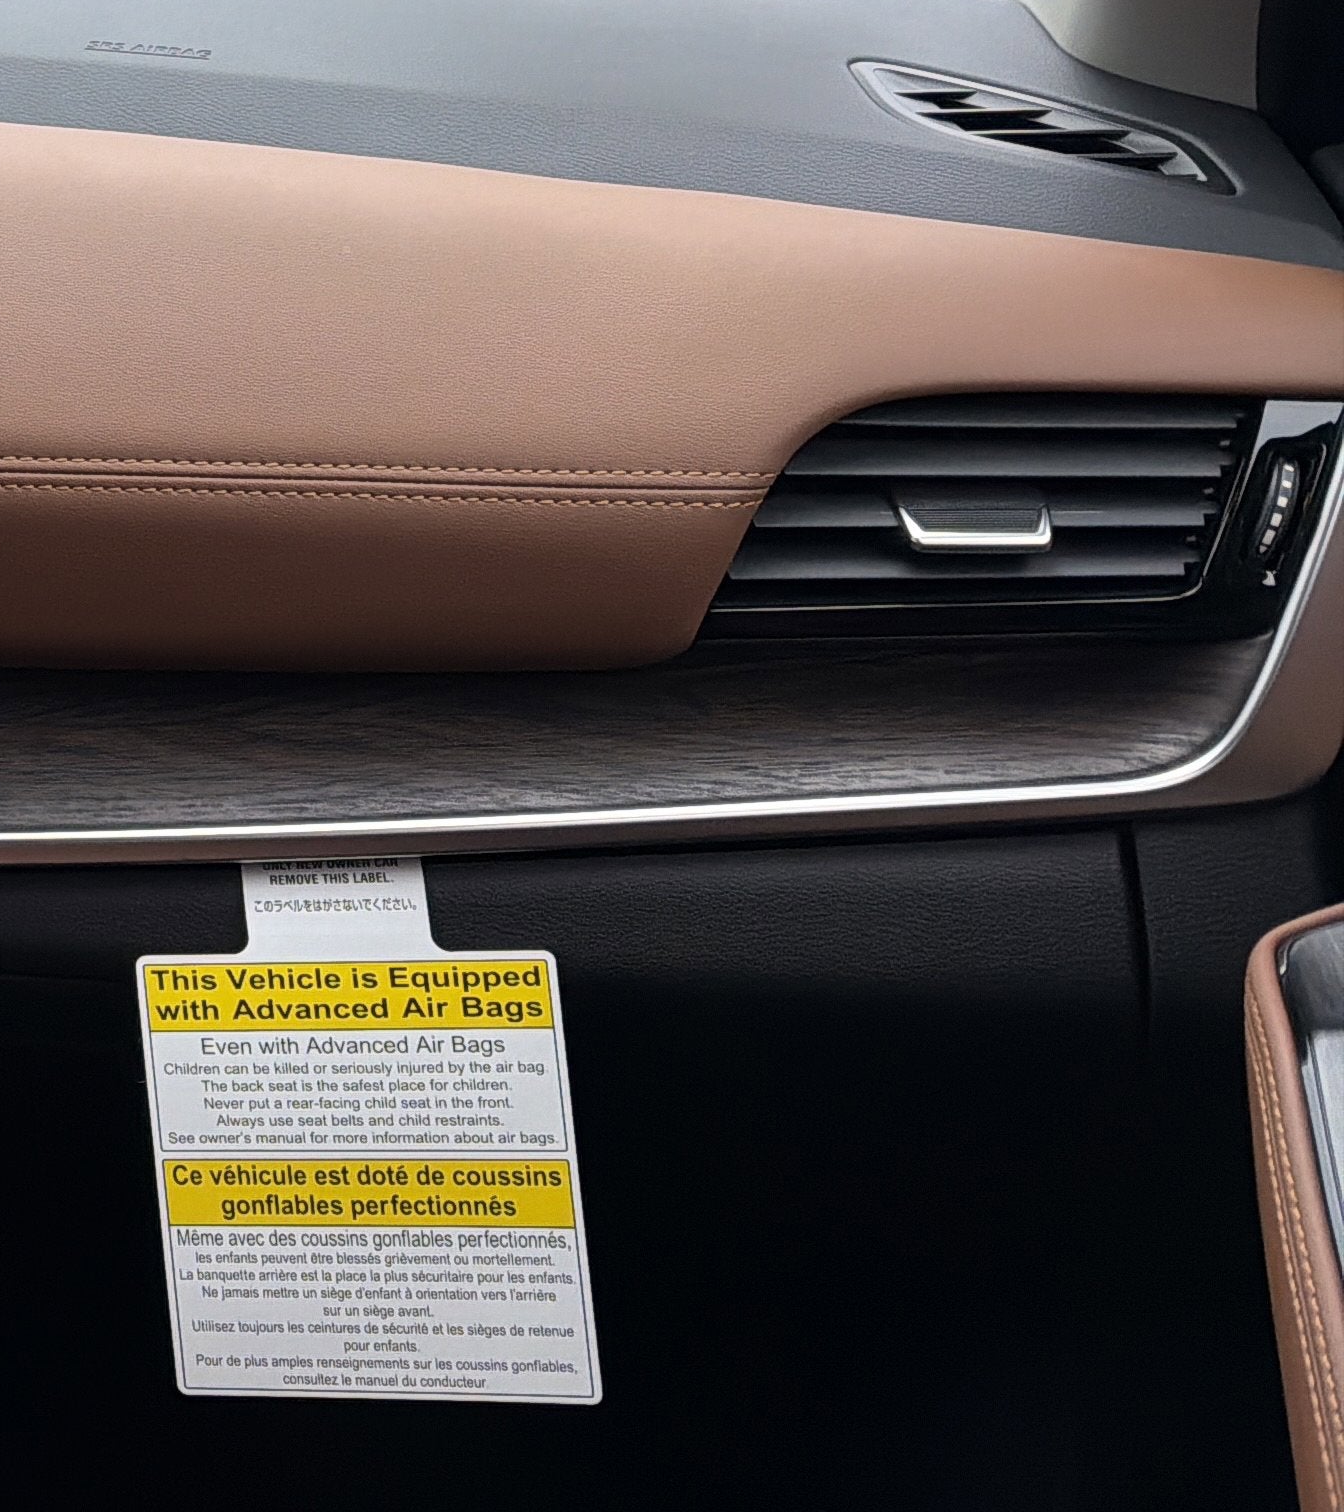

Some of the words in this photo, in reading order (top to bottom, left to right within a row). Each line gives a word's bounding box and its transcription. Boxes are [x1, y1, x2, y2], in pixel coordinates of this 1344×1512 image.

[269, 874, 319, 886] REMOVE
[323, 873, 350, 884] THIS
[353, 872, 395, 884] LABEL.
[254, 898, 417, 913] このラベルをはがさないでください。
[151, 969, 218, 991] This
[225, 968, 341, 990] Vehicle
[351, 968, 378, 989] is
[389, 965, 541, 993] Equipped
[156, 1000, 219, 1021] with
[233, 998, 389, 1020] Advanced
[402, 997, 448, 1018] Air
[462, 997, 543, 1023] Bags
[201, 1037, 252, 1055] Even
[258, 1036, 299, 1055] with
[306, 1036, 408, 1055] Advanced
[416, 1035, 445, 1054] Air
[452, 1036, 505, 1057] Bags
[163, 1062, 220, 1076] Children
[224, 1064, 249, 1075] can
[253, 1063, 270, 1075] be
[274, 1062, 309, 1075] killed
[313, 1064, 327, 1075] or
[331, 1062, 392, 1077] seriously
[397, 1061, 444, 1076] injured
[448, 1061, 465, 1076] by
[469, 1061, 491, 1073] the
[496, 1060, 514, 1073] air
[201, 1080, 228, 1092] The
[232, 1080, 264, 1092] back
[268, 1080, 297, 1092] seat
[301, 1080, 313, 1092] is
[317, 1079, 339, 1092] the
[342, 1079, 385, 1092] safest
[388, 1078, 426, 1094] place
[429, 1079, 448, 1091] for
[452, 1078, 512, 1091] children.
[172, 1164, 203, 1186] Ce
[209, 1164, 307, 1186] véhicule
[314, 1165, 350, 1186] est
[357, 1165, 408, 1186] doté
[416, 1165, 445, 1186] de
[452, 1165, 562, 1187] coussins
[221, 1194, 343, 1221] gonflables
[351, 1194, 517, 1220] perfectionnés
